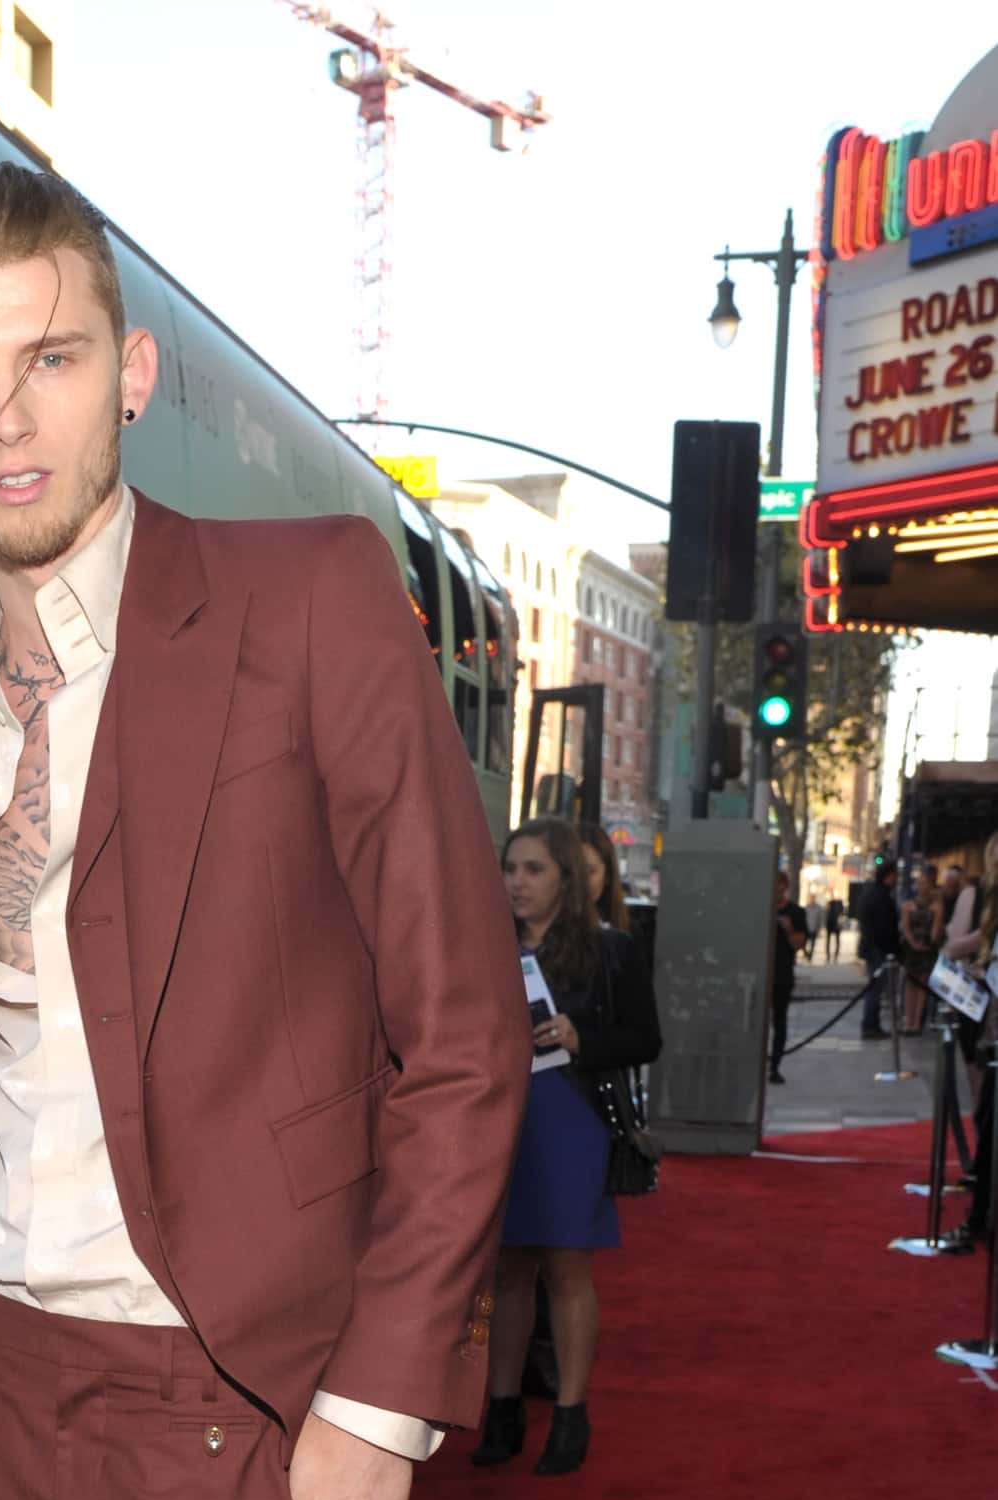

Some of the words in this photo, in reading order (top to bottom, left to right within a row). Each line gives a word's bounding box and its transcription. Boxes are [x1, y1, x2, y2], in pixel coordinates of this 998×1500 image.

[844, 349, 936, 411] JUNE
[944, 334, 995, 388] 26
[847, 397, 973, 463] CROWE
